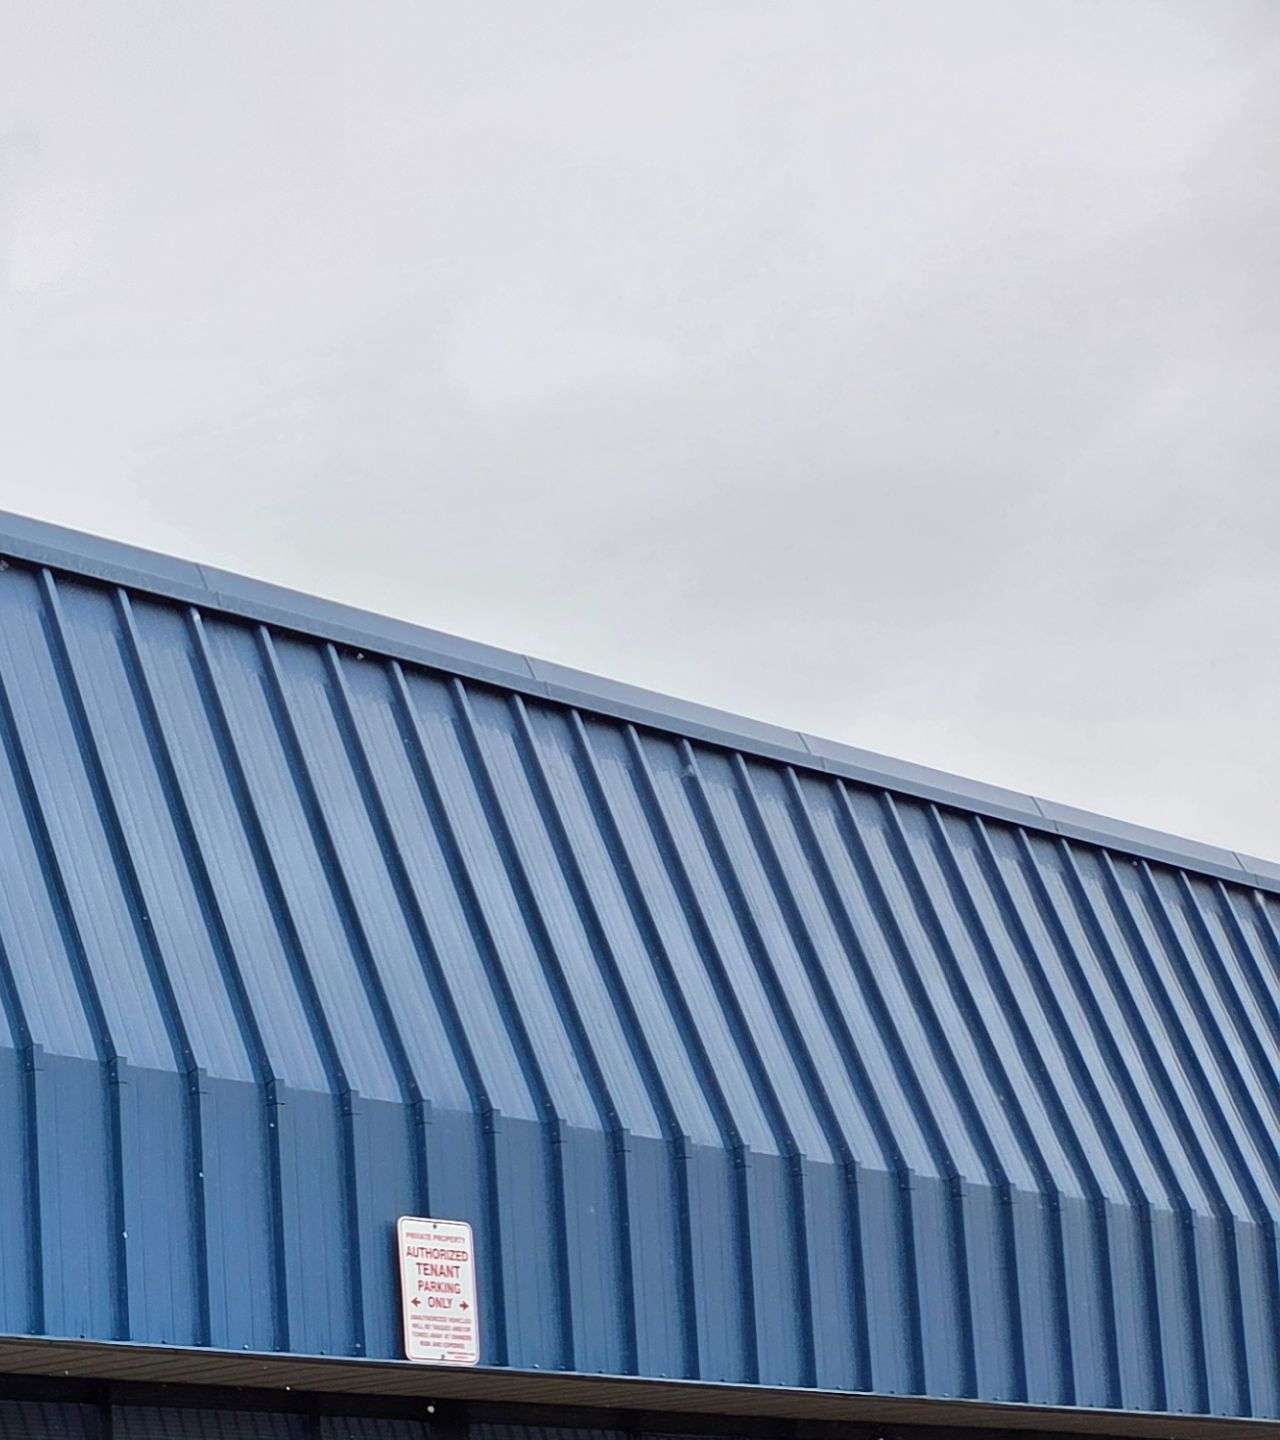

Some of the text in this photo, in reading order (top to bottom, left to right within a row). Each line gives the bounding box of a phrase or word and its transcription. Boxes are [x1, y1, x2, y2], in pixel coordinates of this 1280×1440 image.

[406, 1246, 468, 1261] AUTHORIZED
[416, 1262, 460, 1278] TENANT
[418, 1280, 461, 1294] PARKING
[428, 1296, 454, 1309] ONLY
